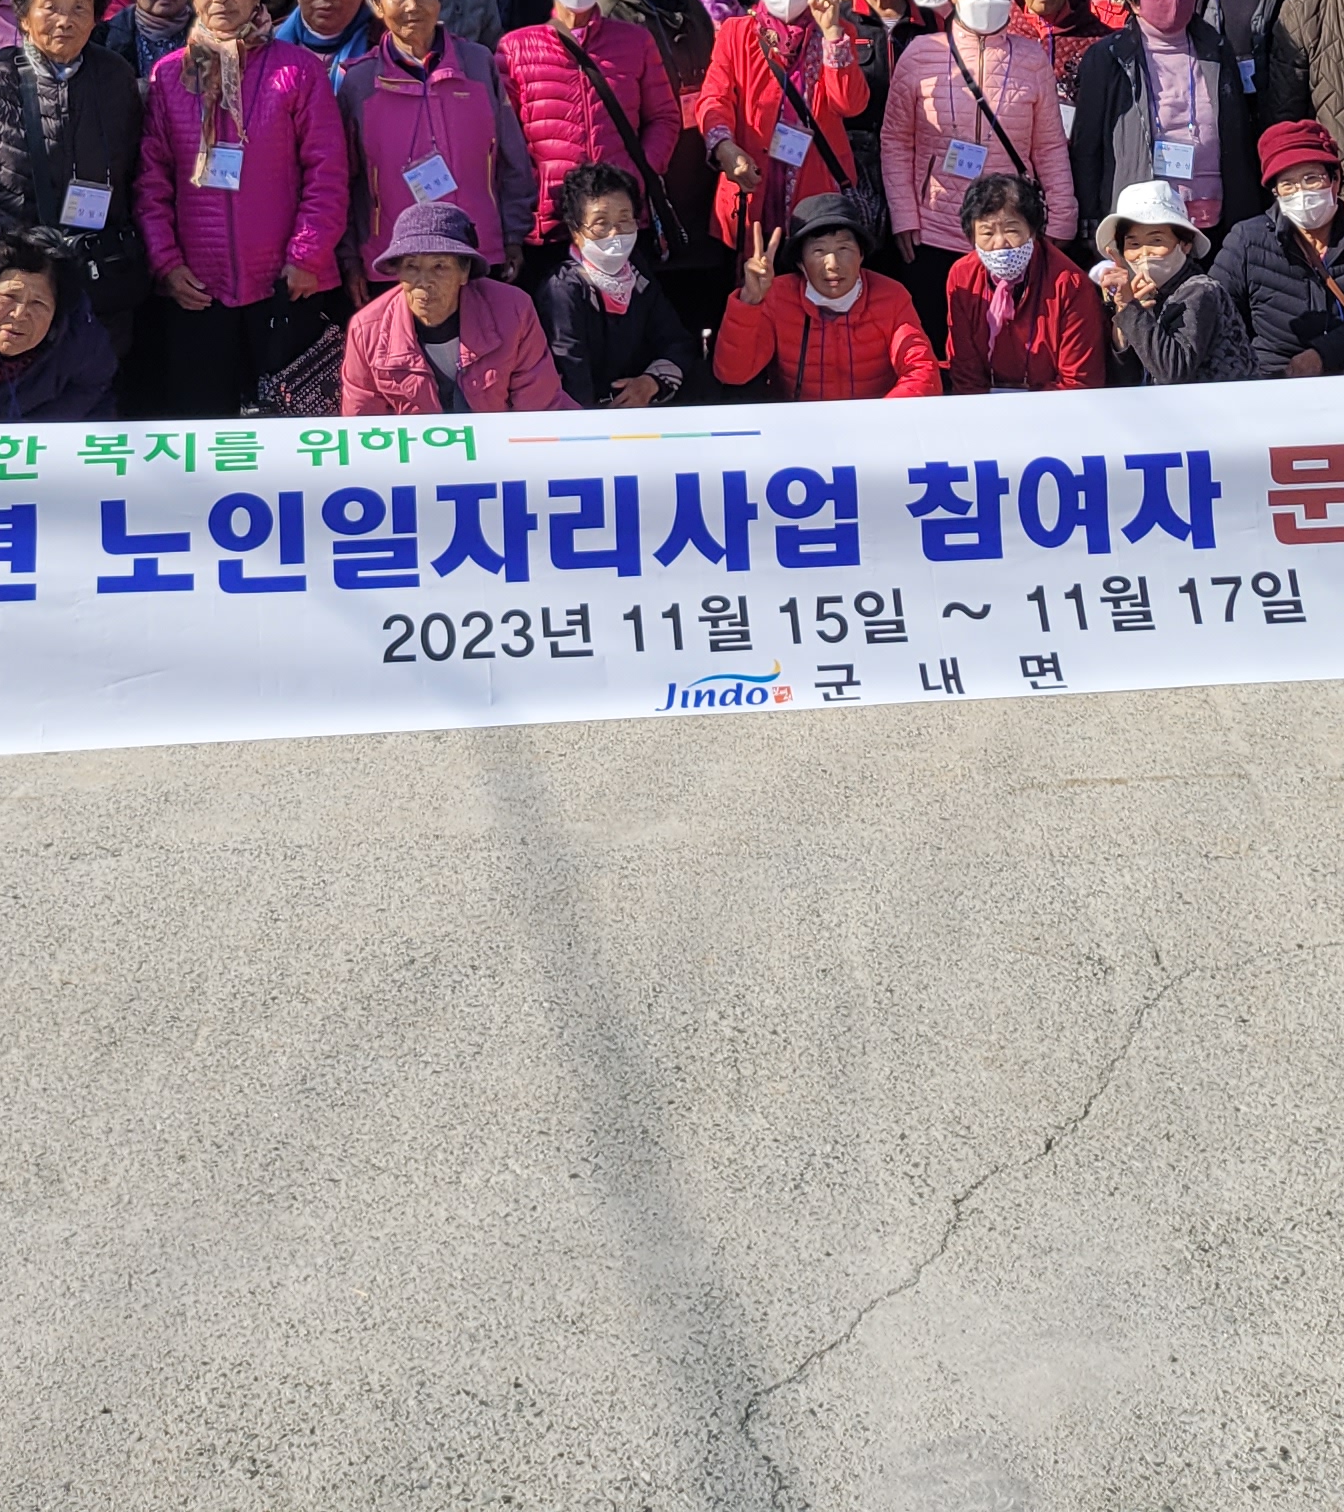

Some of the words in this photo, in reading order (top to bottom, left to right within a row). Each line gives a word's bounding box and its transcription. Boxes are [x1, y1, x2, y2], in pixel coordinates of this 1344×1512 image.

[77, 429, 265, 476] 복지를
[296, 425, 478, 467] 위하여
[96, 465, 861, 594] 노인일자리사업
[906, 450, 1222, 562] 참여자
[382, 602, 594, 664] 2023년
[622, 594, 754, 653] 11월
[779, 587, 908, 645] 15일
[1026, 575, 1157, 633] 11월
[1177, 569, 1308, 626] 17일
[655, 682, 769, 712] Jindo
